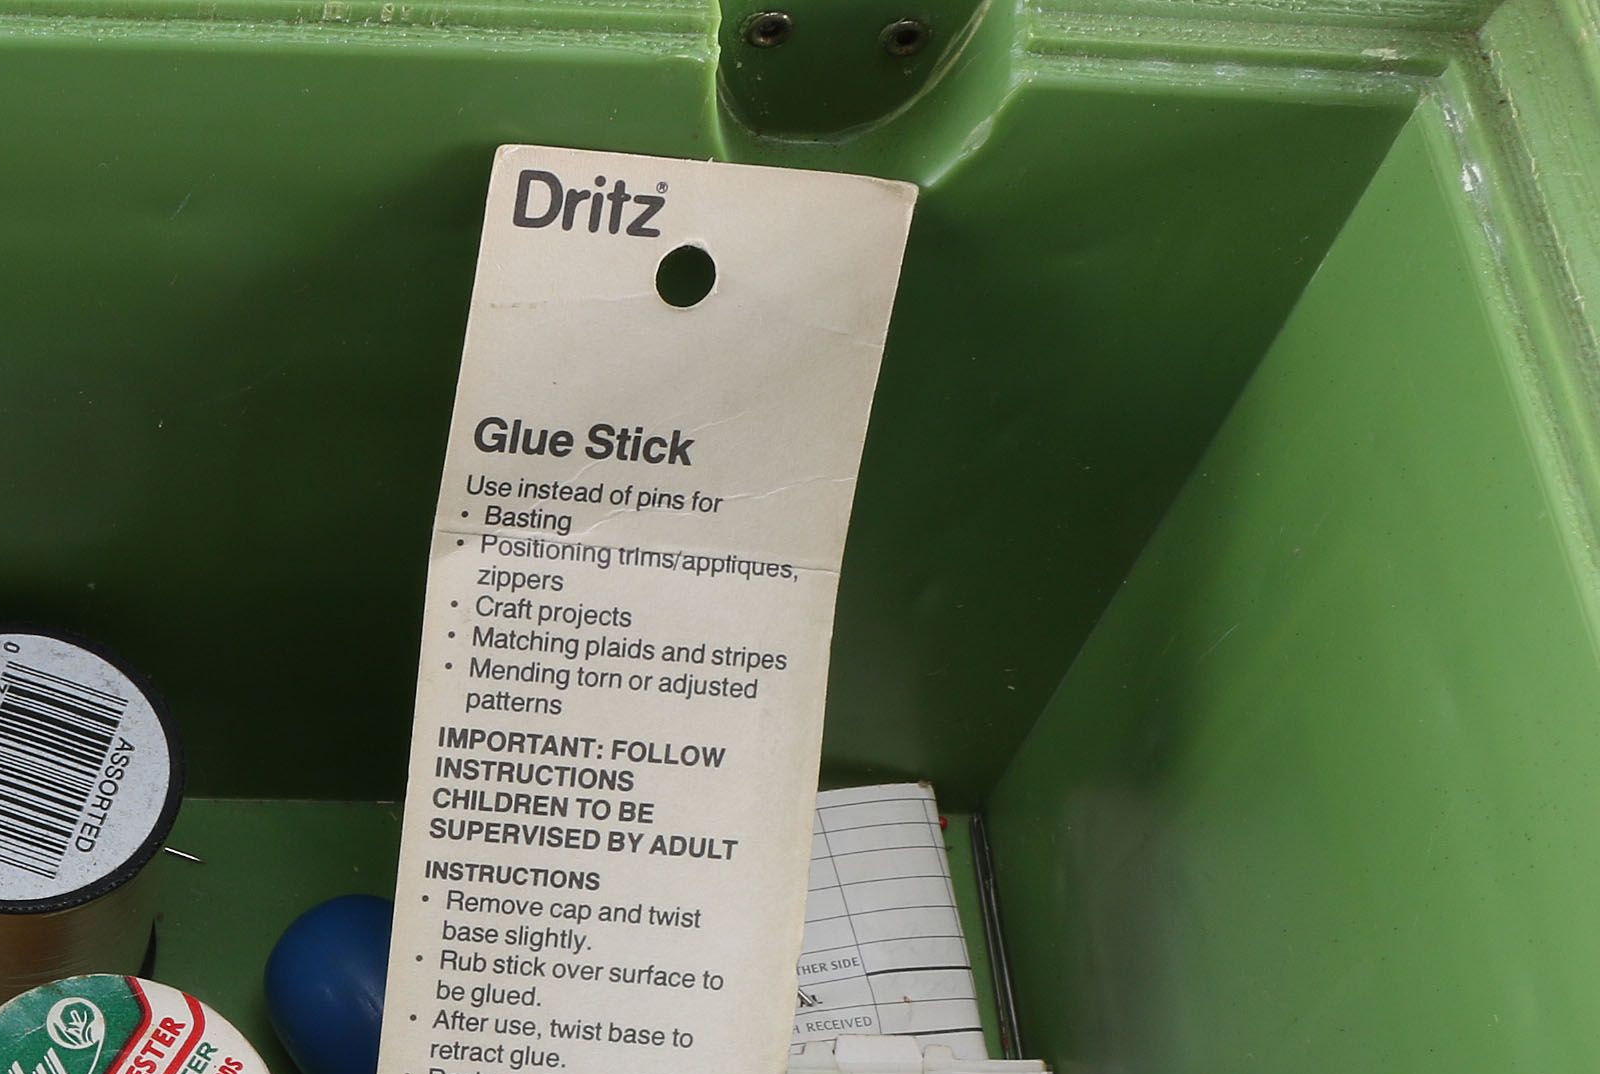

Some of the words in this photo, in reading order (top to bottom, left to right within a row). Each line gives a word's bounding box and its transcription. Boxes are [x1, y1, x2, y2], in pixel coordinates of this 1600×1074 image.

[473, 416, 575, 458] Glue
[584, 423, 696, 467] Stick
[466, 474, 513, 498] Use
[517, 477, 604, 504] instead
[609, 484, 634, 506] of
[635, 487, 685, 512] pins
[691, 490, 724, 513] for
[484, 504, 573, 537] Basting
[481, 533, 612, 570] Positioning
[476, 564, 564, 594] zippers
[475, 594, 534, 621] Craft
[537, 603, 632, 630] projects
[472, 625, 580, 660] Matching
[584, 635, 656, 661] plaids
[661, 643, 706, 665] and
[710, 646, 788, 673] stripes
[469, 656, 571, 691] Mending
[576, 666, 623, 689] torn
[628, 674, 654, 691] or
[657, 672, 759, 700] adjusted
[465, 690, 563, 716] patterns
[438, 726, 604, 760] IMPORTANT:
[610, 739, 727, 768] FOLLOW
[435, 756, 635, 792] INSTRUCTIONS
[74, 736, 135, 852] ASSORTED
[432, 787, 569, 818] CHILDREN
[575, 797, 612, 821] TO
[618, 800, 655, 824] BE
[428, 817, 601, 850] SUPERVISED
[607, 830, 645, 854] BY
[648, 834, 739, 861] ADULT
[424, 860, 601, 891] INSTRUCTIONS
[446, 889, 544, 917] Remove
[549, 902, 592, 925] cap
[597, 903, 643, 924] and
[648, 905, 702, 929] twist
[441, 919, 499, 944] base
[504, 924, 592, 956] slightly.
[439, 949, 487, 973] Rub
[492, 954, 547, 977] stick
[551, 962, 605, 981] over
[608, 964, 696, 989] surface
[702, 970, 724, 991] to
[831, 957, 860, 971] SIDE
[431, 1009, 490, 1033] After
[494, 1018, 542, 1041] use,
[549, 1018, 603, 1042] twist
[607, 1021, 666, 1047] base
[671, 1028, 694, 1049] to
[806, 1016, 872, 1033] RECEIVED
